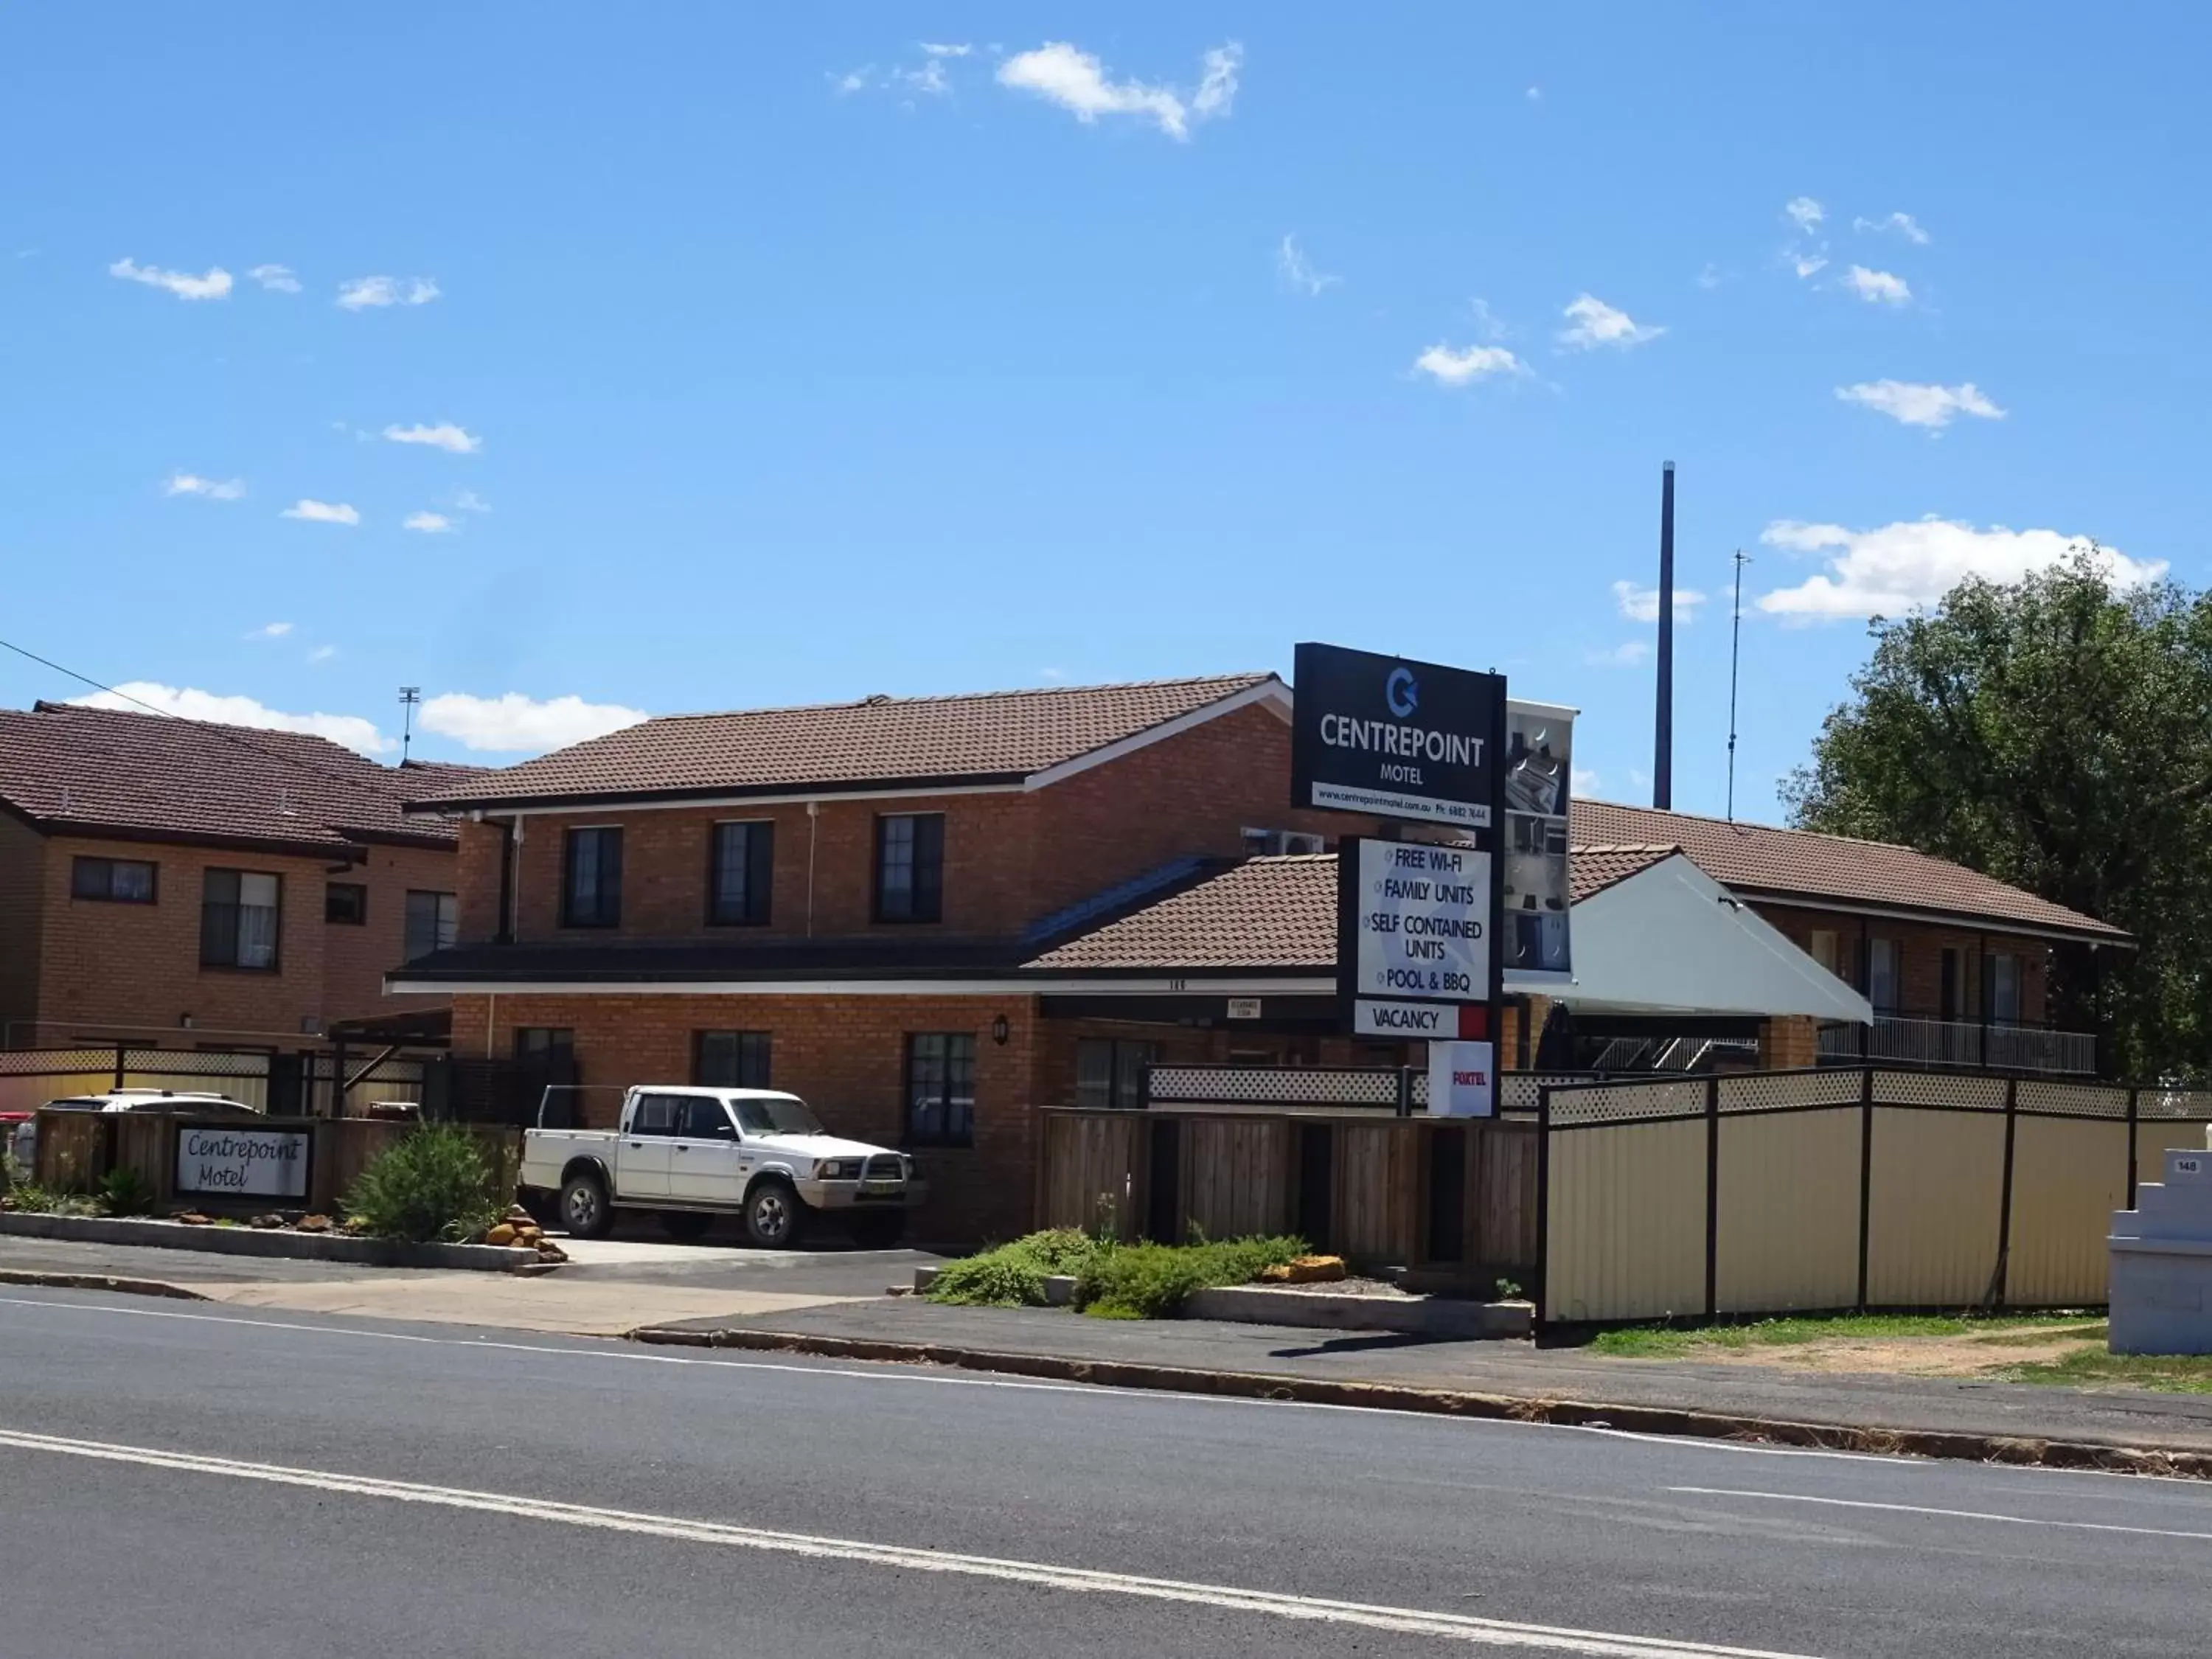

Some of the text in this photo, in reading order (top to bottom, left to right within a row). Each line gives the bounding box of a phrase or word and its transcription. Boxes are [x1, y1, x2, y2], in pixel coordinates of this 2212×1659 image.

[1321, 713, 1484, 768] CENTREPOINT
[1380, 763, 1424, 785] MOTEL
[1395, 849, 1462, 872] FREE WI-FI
[1385, 878, 1474, 905] FAMILY UNITS
[1371, 912, 1482, 939] SELF CONTAINED
[1405, 939, 1445, 960] UNITS
[1387, 969, 1470, 993] POOL & BBQ
[1373, 1008, 1440, 1029] VACANCY
[1453, 1071, 1486, 1086] FOXTEL
[188, 1133, 302, 1166] Centrepoint
[198, 1163, 249, 1187] Motel
